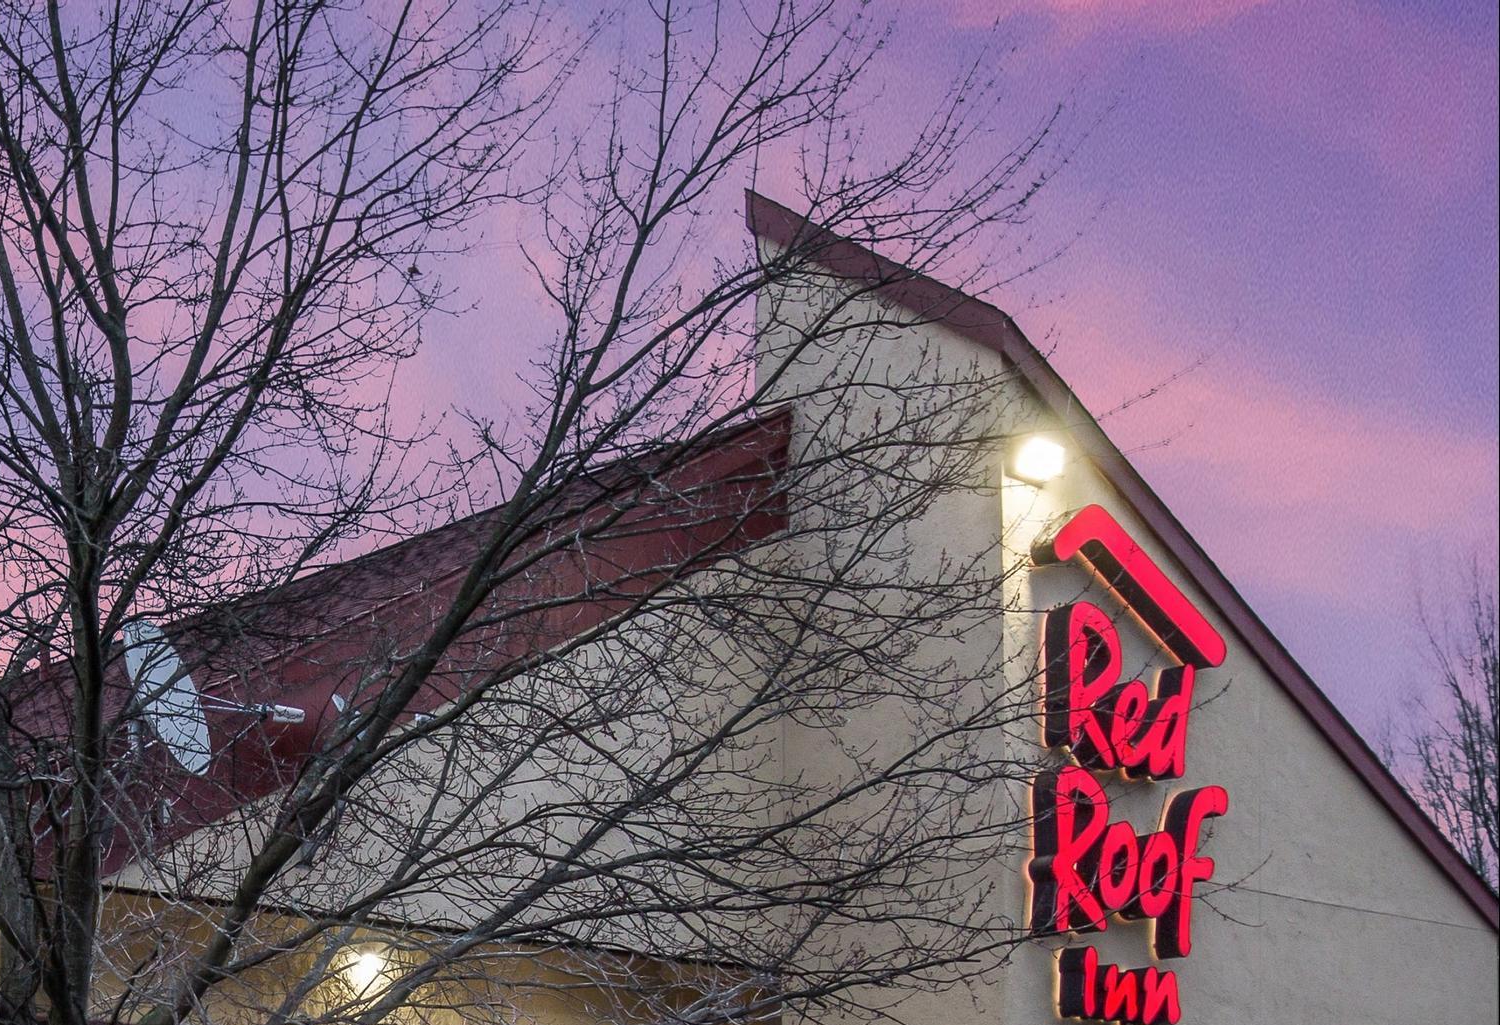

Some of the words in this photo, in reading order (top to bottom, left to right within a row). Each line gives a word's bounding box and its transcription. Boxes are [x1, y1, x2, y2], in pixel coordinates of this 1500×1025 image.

[1056, 601, 1195, 778] Red
[1042, 766, 1229, 957] Roof
[1071, 947, 1181, 1025] Inn
